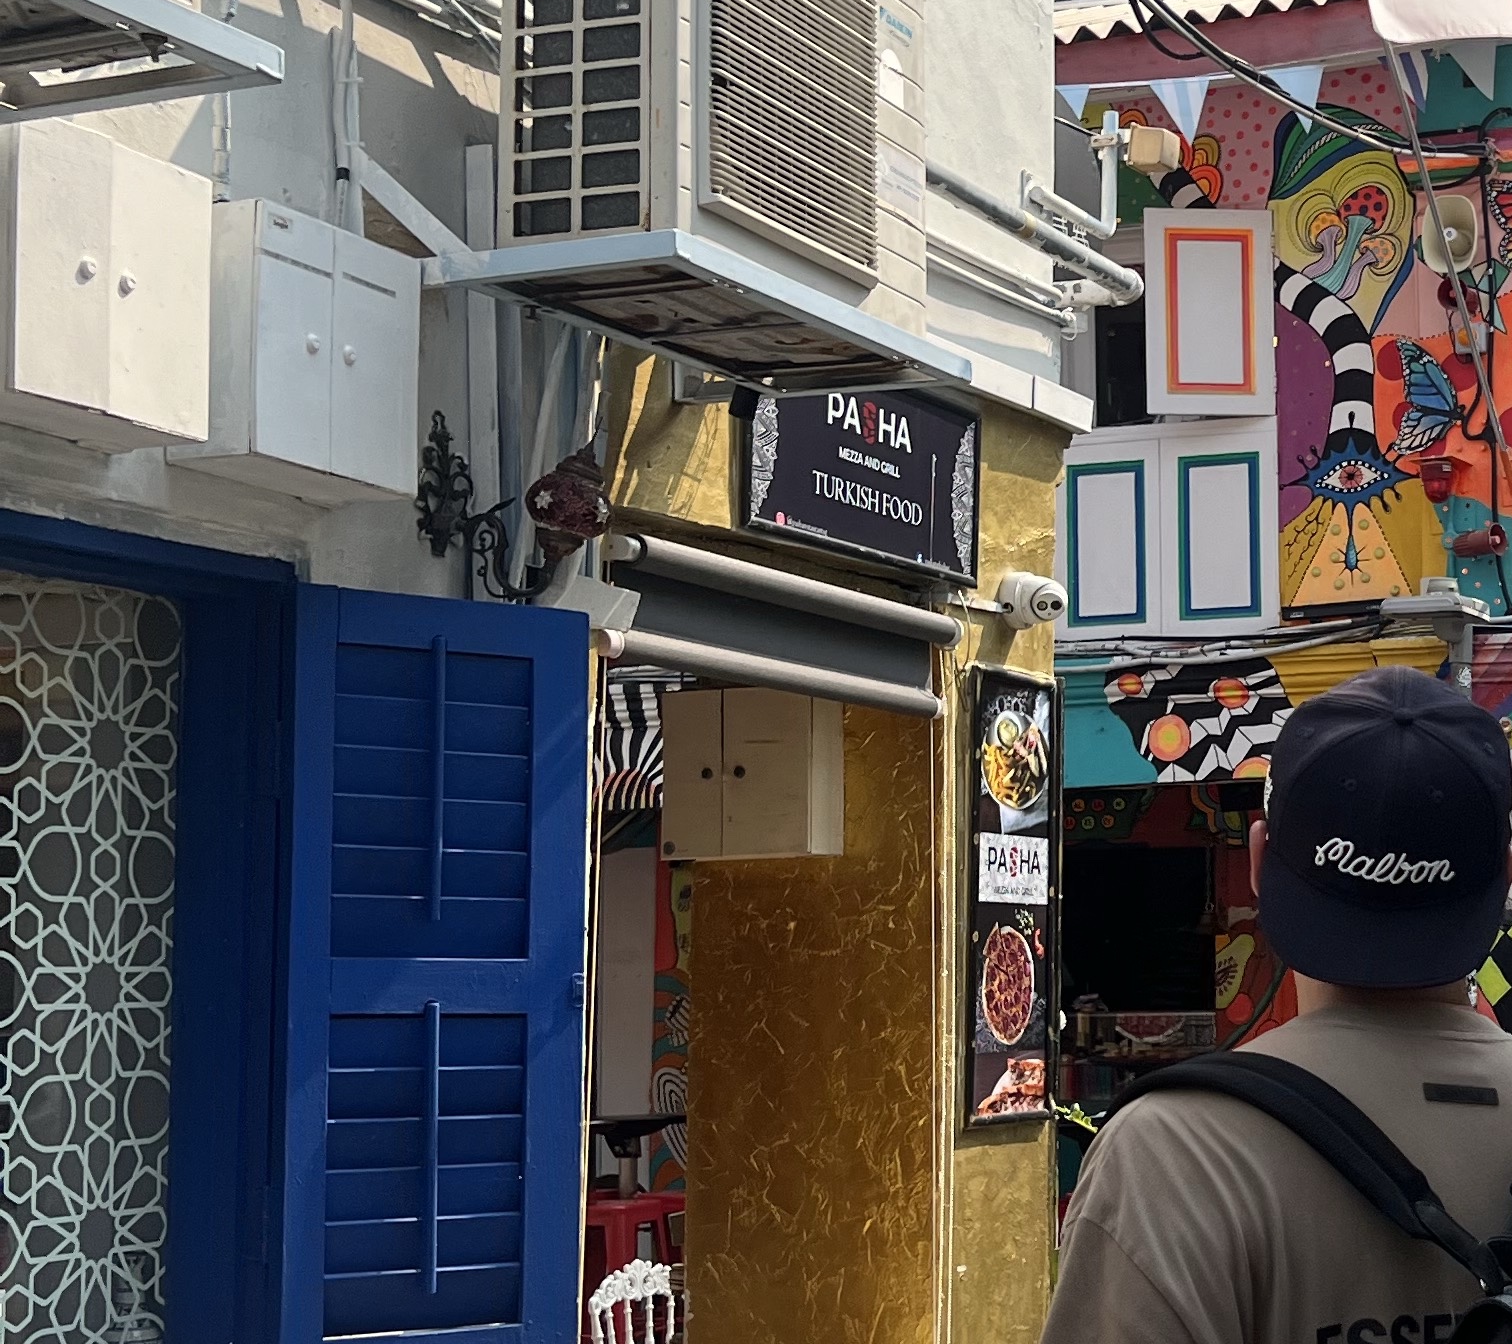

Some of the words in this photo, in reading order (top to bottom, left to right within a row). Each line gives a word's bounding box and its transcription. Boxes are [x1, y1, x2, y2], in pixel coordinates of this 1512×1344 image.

[827, 392, 913, 454] PASHA
[838, 446, 864, 466] MEZZA
[864, 455, 880, 471] AND
[880, 461, 901, 478] GRILL
[812, 470, 880, 515] TURKISH
[882, 494, 923, 527] FOOD
[987, 846, 1041, 877] PASHA
[1314, 837, 1456, 885] Malbon
